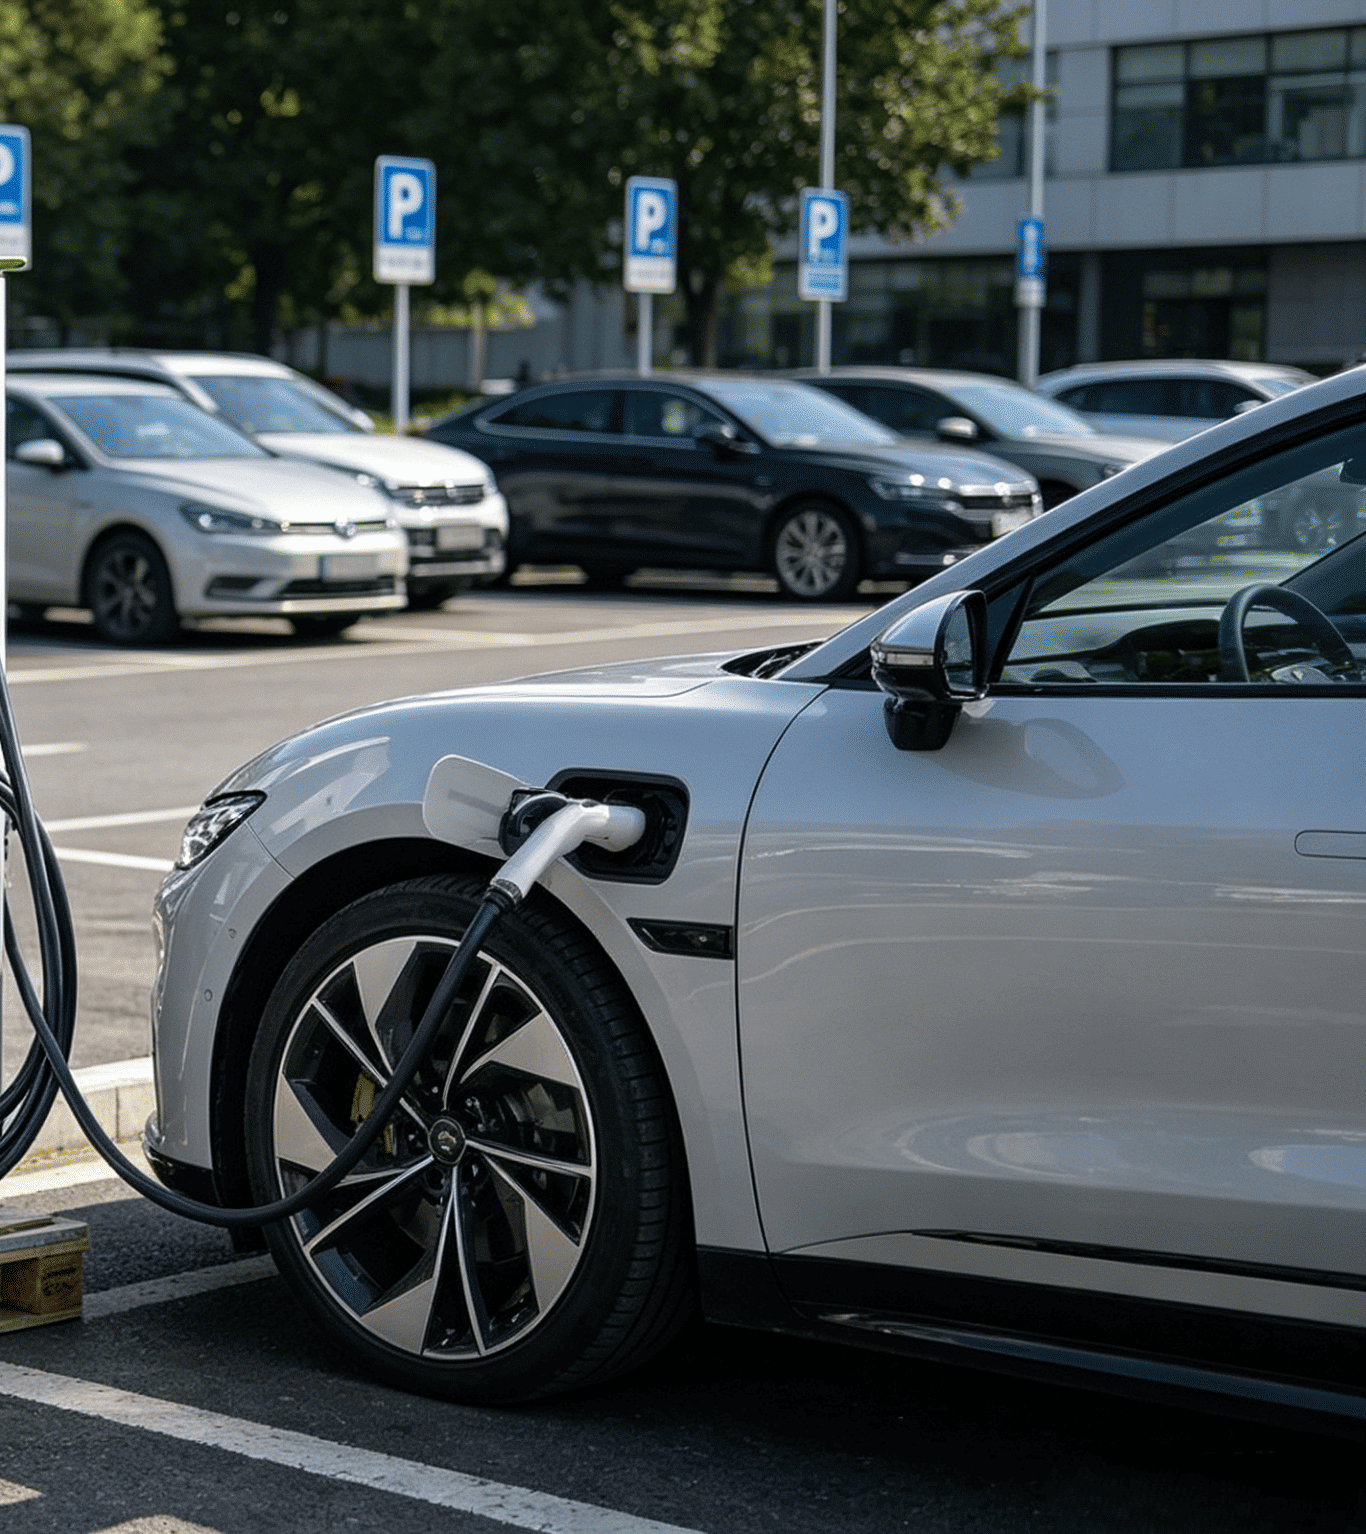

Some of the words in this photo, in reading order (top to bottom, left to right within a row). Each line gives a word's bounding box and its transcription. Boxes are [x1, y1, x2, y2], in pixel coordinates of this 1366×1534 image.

[388, 172, 424, 239] P
[636, 191, 666, 250] P
[809, 200, 838, 261] P
